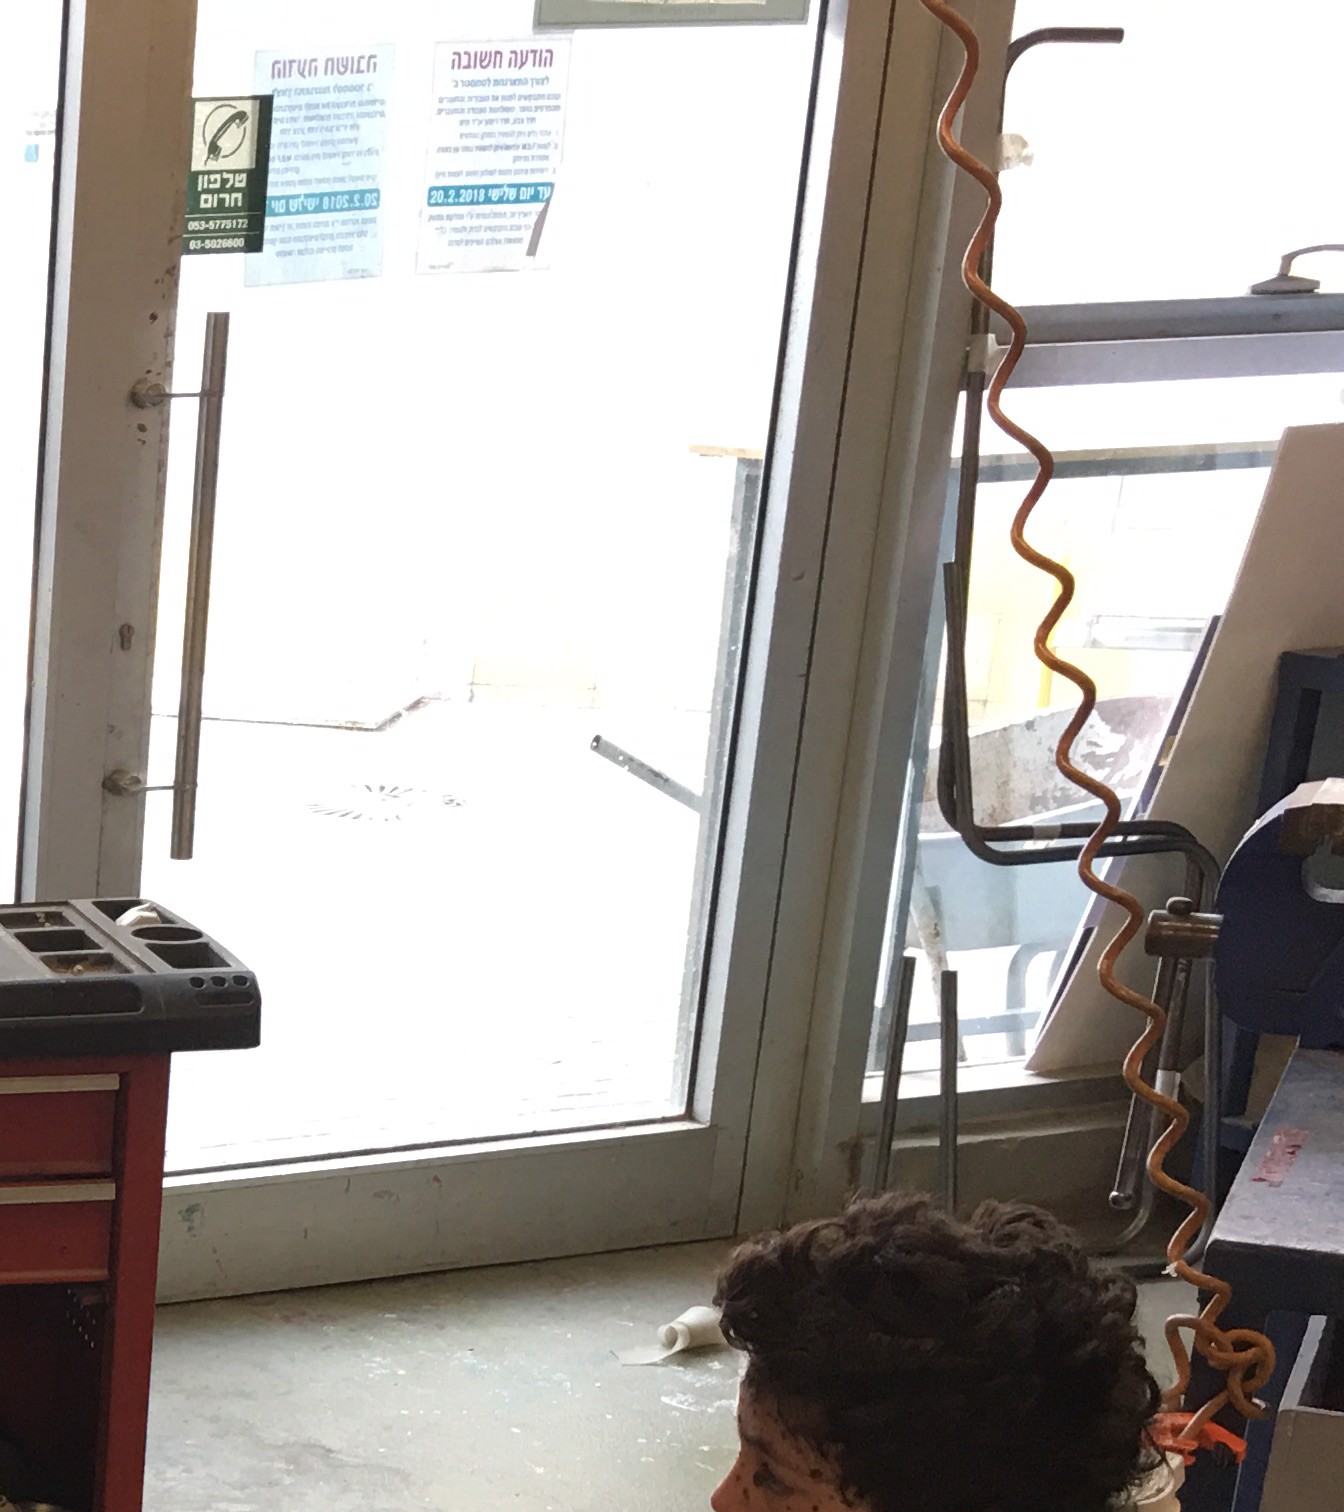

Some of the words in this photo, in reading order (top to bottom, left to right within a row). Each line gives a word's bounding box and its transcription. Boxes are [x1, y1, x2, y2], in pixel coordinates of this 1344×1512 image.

[451, 50, 504, 70] חשובה
[508, 48, 554, 71] הודעה
[198, 172, 247, 191] טלפון
[200, 193, 243, 208] חרום
[429, 188, 486, 204] 20.2.2018
[488, 184, 517, 201] שלישי
[519, 188, 534, 201] יום
